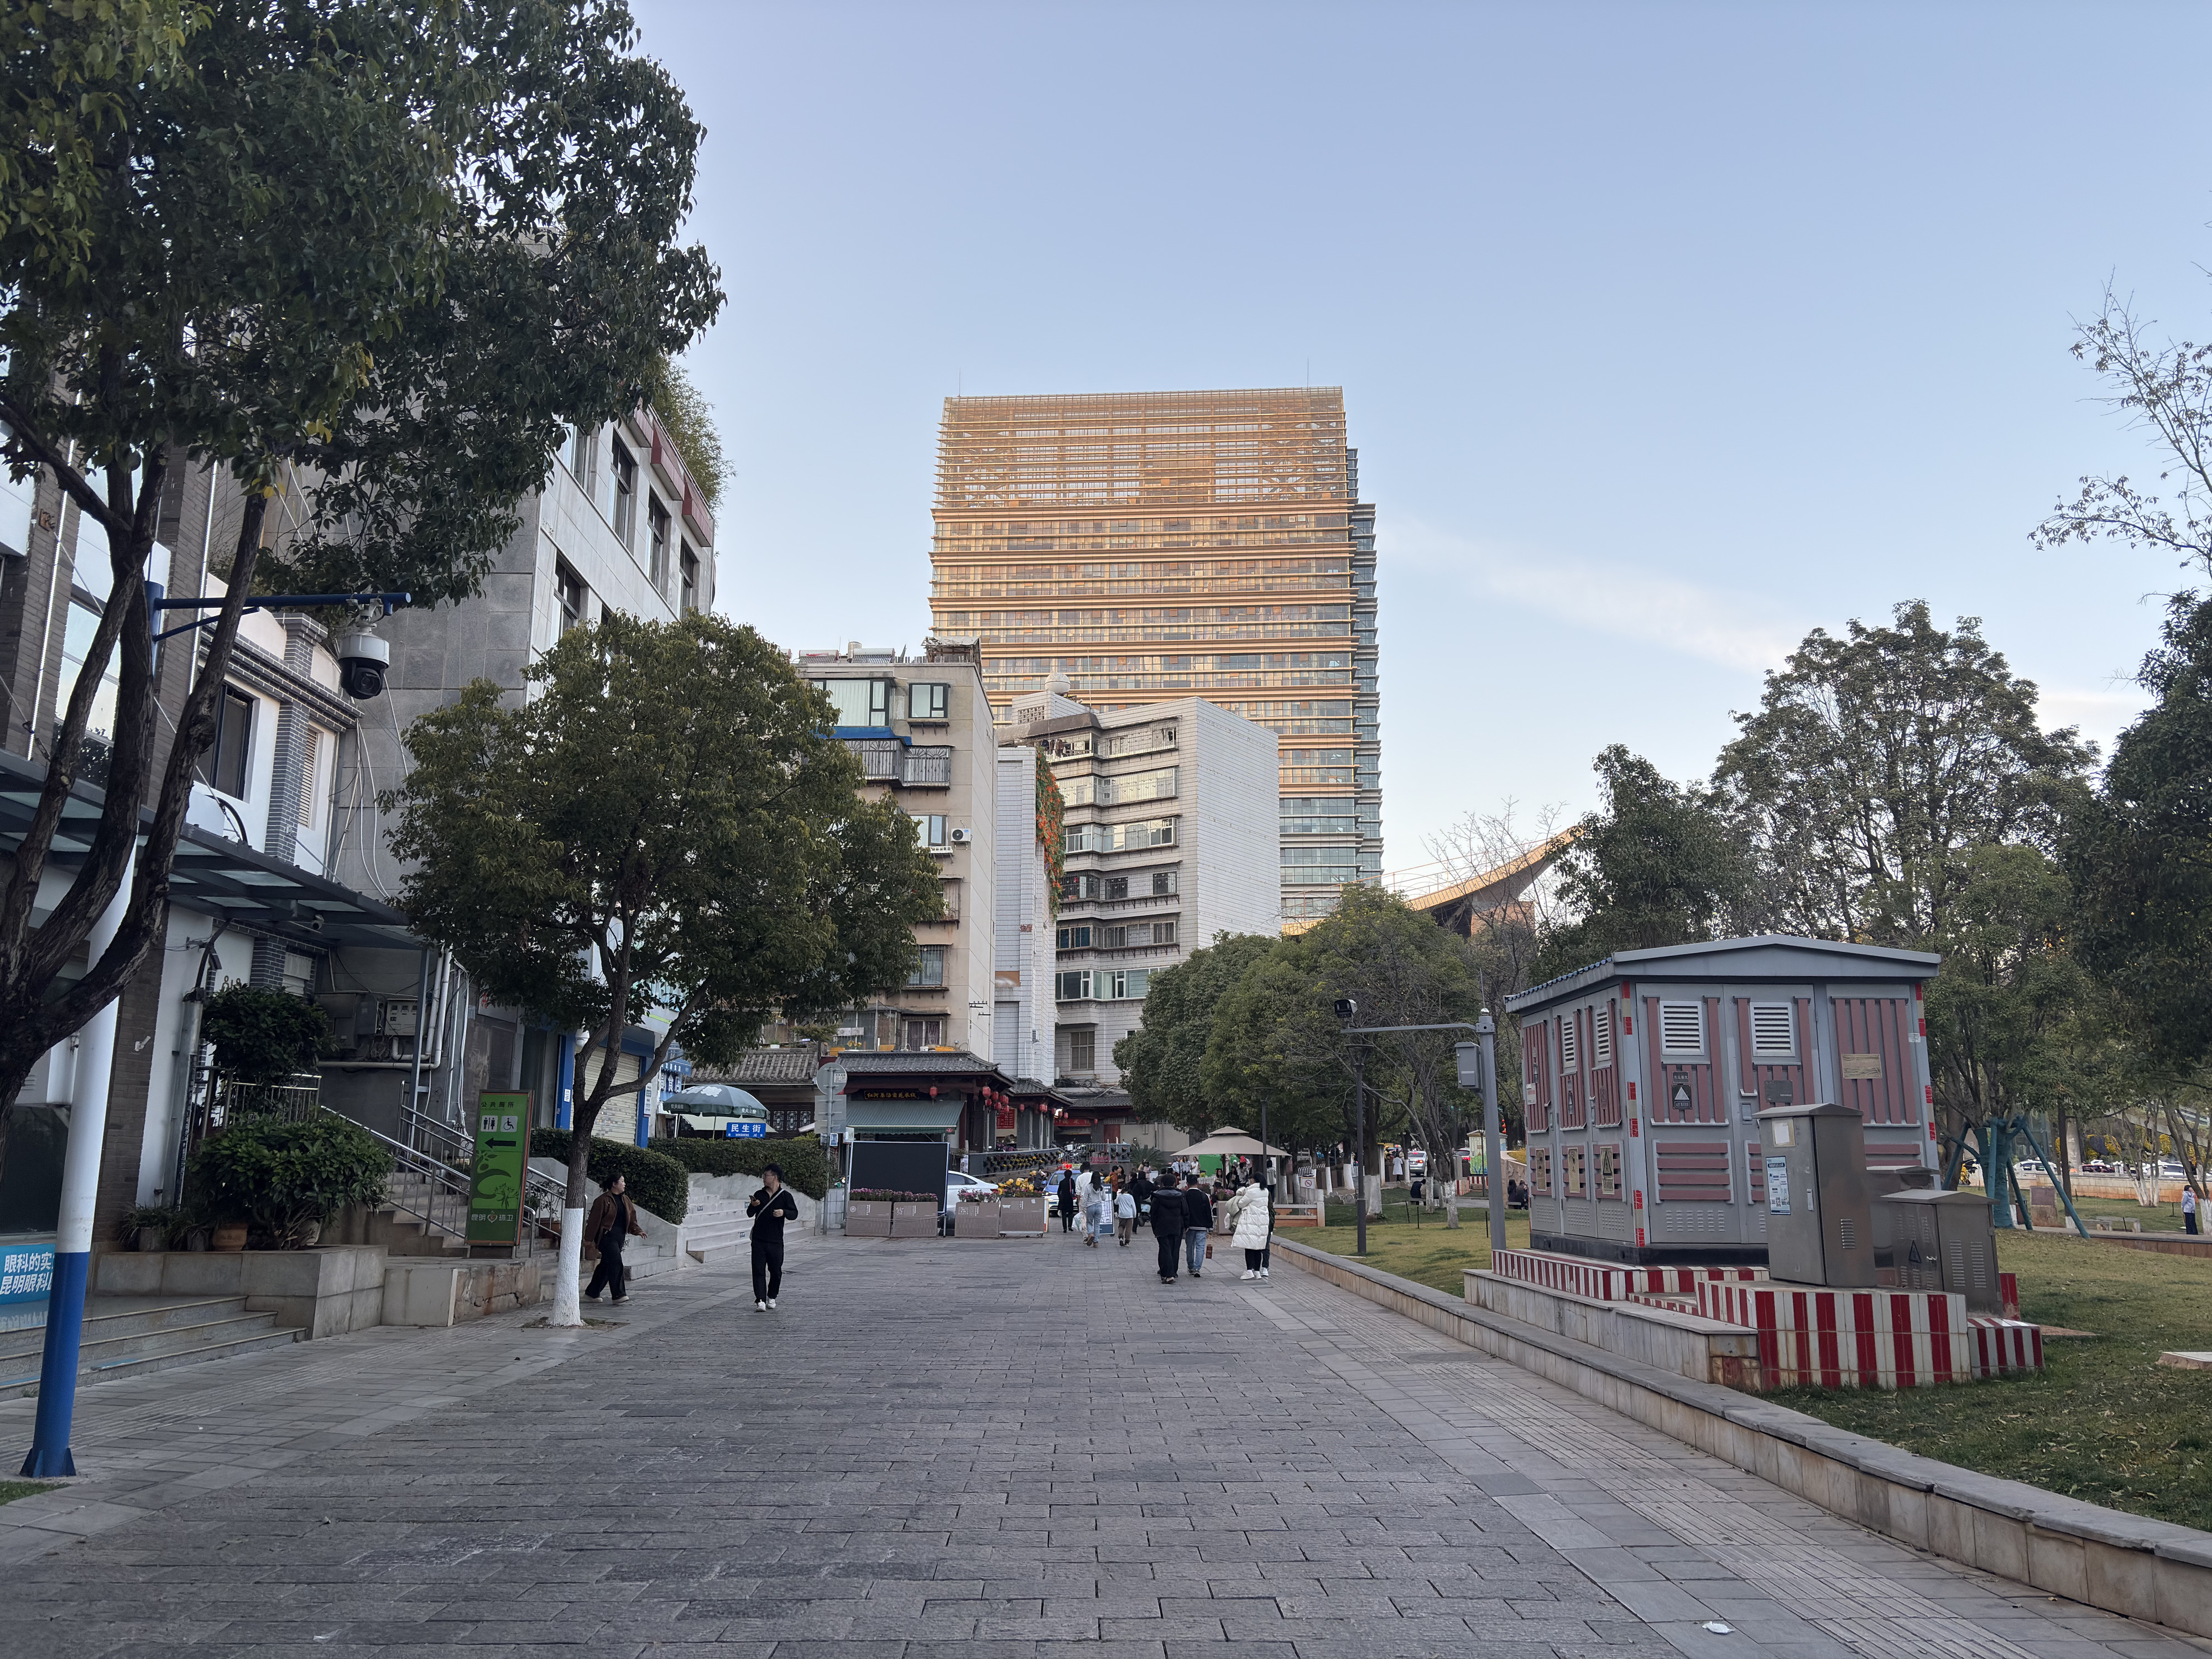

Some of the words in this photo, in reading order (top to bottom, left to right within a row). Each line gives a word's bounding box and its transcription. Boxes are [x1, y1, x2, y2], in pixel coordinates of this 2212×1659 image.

[731, 1124, 761, 1133] 民生街
[4, 1252, 54, 1273] 眼科的实
